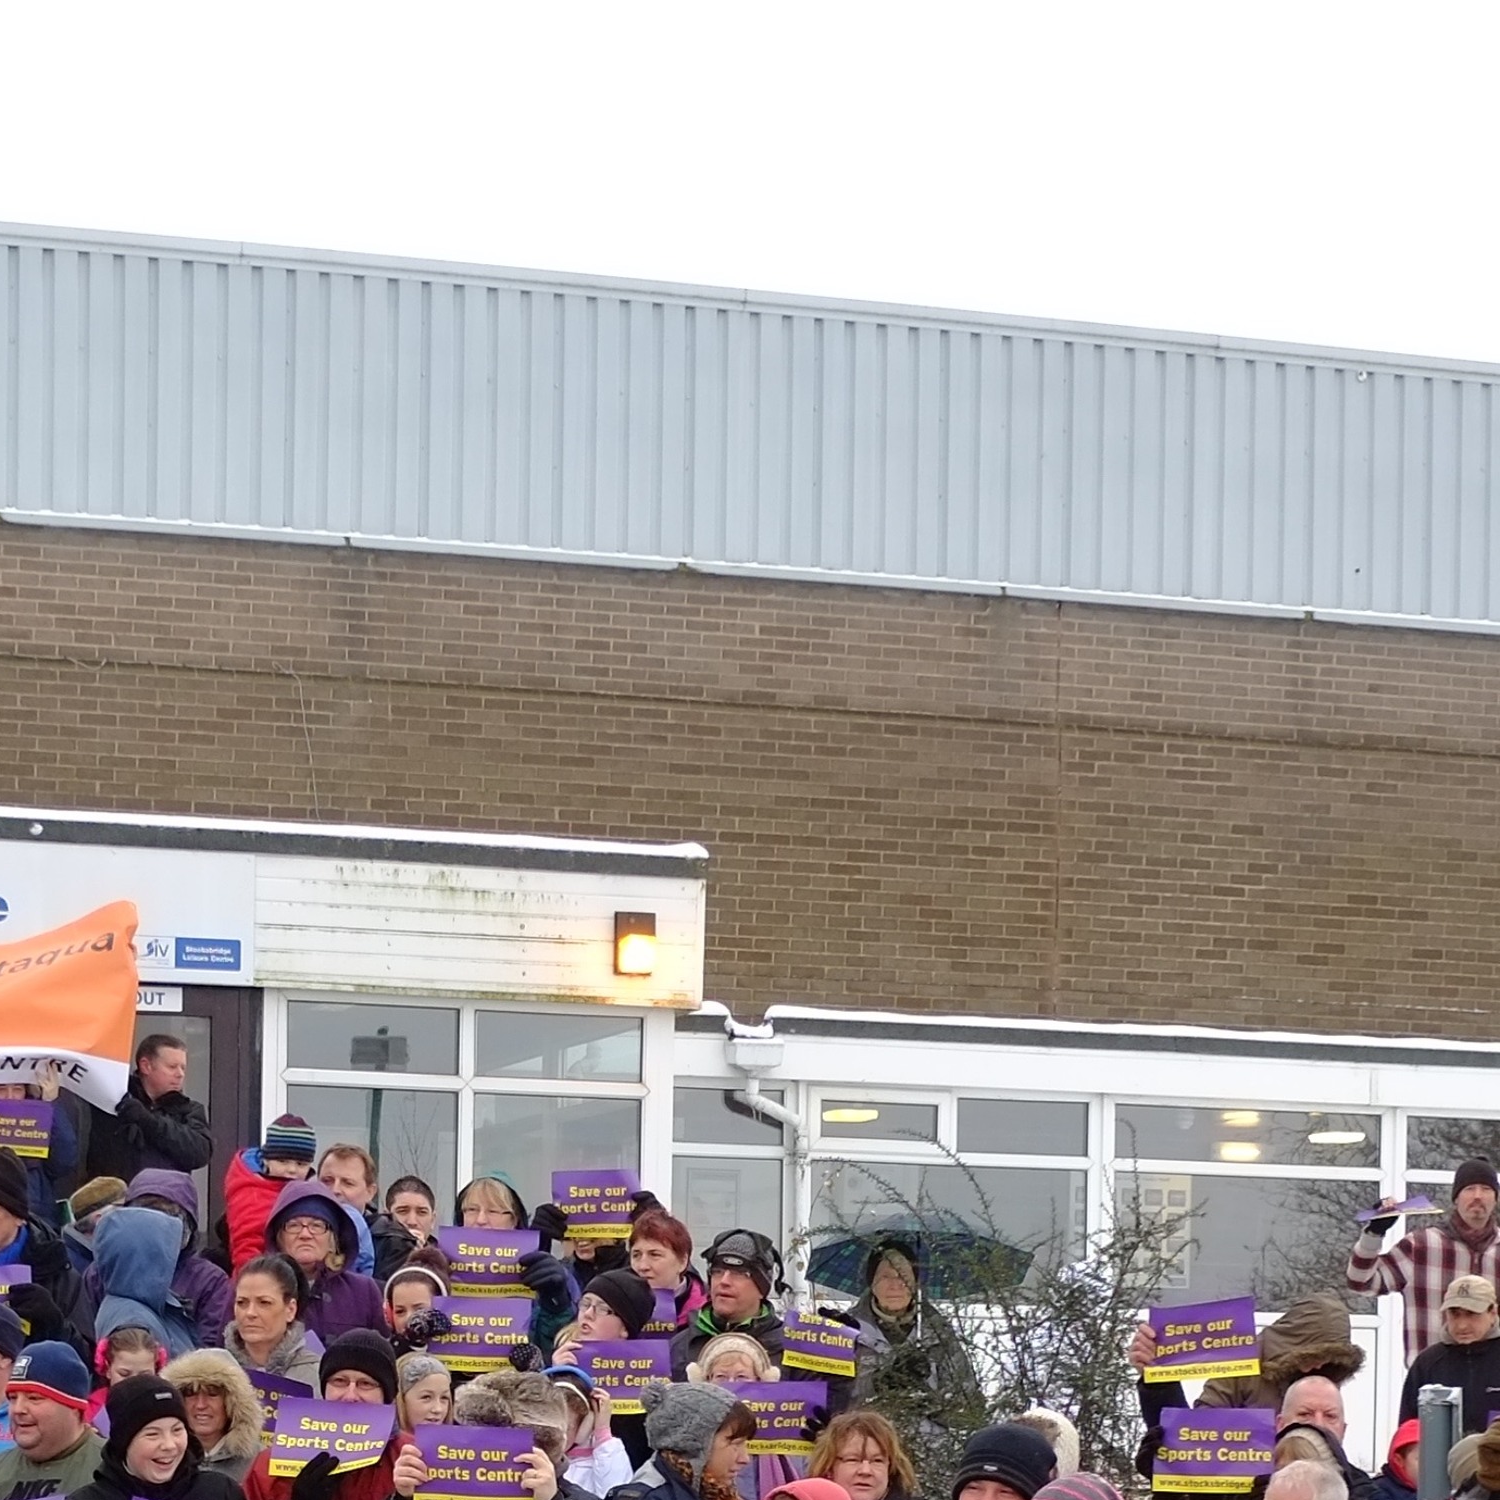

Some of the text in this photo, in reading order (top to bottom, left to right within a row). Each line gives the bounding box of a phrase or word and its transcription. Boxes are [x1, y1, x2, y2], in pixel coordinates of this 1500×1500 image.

[14, 1129, 48, 1139] Centre
[569, 1186, 627, 1198] Save our
[458, 1244, 518, 1258] Save our
[451, 1313, 513, 1328] Save our
[1165, 1318, 1234, 1337] Save our
[783, 1326, 854, 1349] Sports Centre
[1202, 1334, 1254, 1349] Centre
[592, 1357, 653, 1370] Save our
[1150, 1363, 1253, 1379] www.stocksbridge.com
[742, 1399, 805, 1412] Save our
[300, 1417, 371, 1435] Save our
[1179, 1427, 1251, 1442] Save our
[276, 1433, 386, 1453] Sports Centre
[437, 1445, 509, 1462] Save our
[1157, 1447, 1272, 1463] Sports Centre
